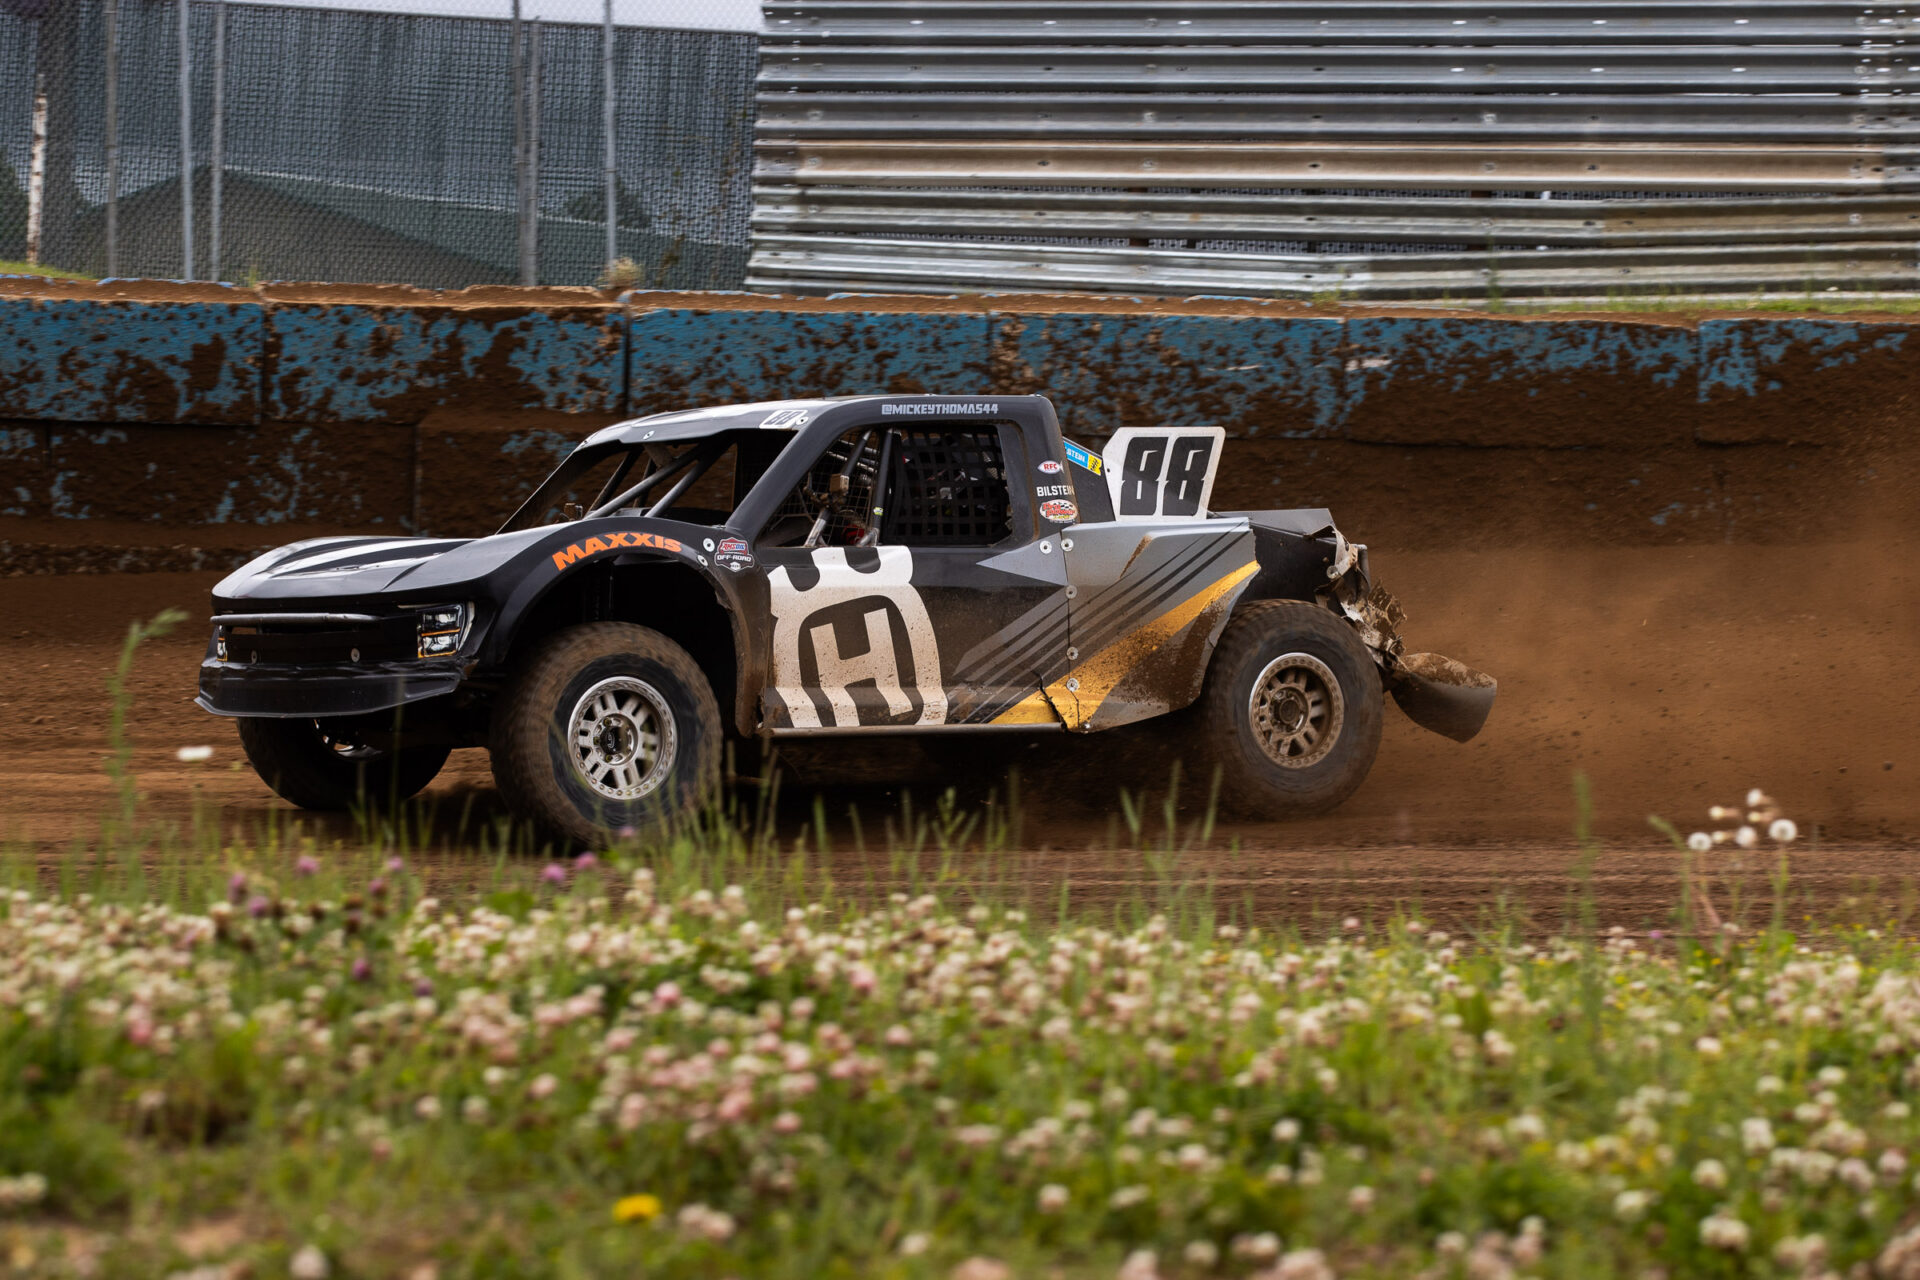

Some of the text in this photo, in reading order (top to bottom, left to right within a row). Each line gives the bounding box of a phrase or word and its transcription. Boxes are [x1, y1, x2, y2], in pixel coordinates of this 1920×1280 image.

[881, 403, 999, 415] @MICKEYTHOMAS44
[763, 411, 804, 425] 88
[1065, 447, 1086, 463] STEIN
[1120, 436, 1215, 517] 88
[1036, 485, 1075, 497] BILSTEIN
[552, 532, 682, 571] MAXXIS
